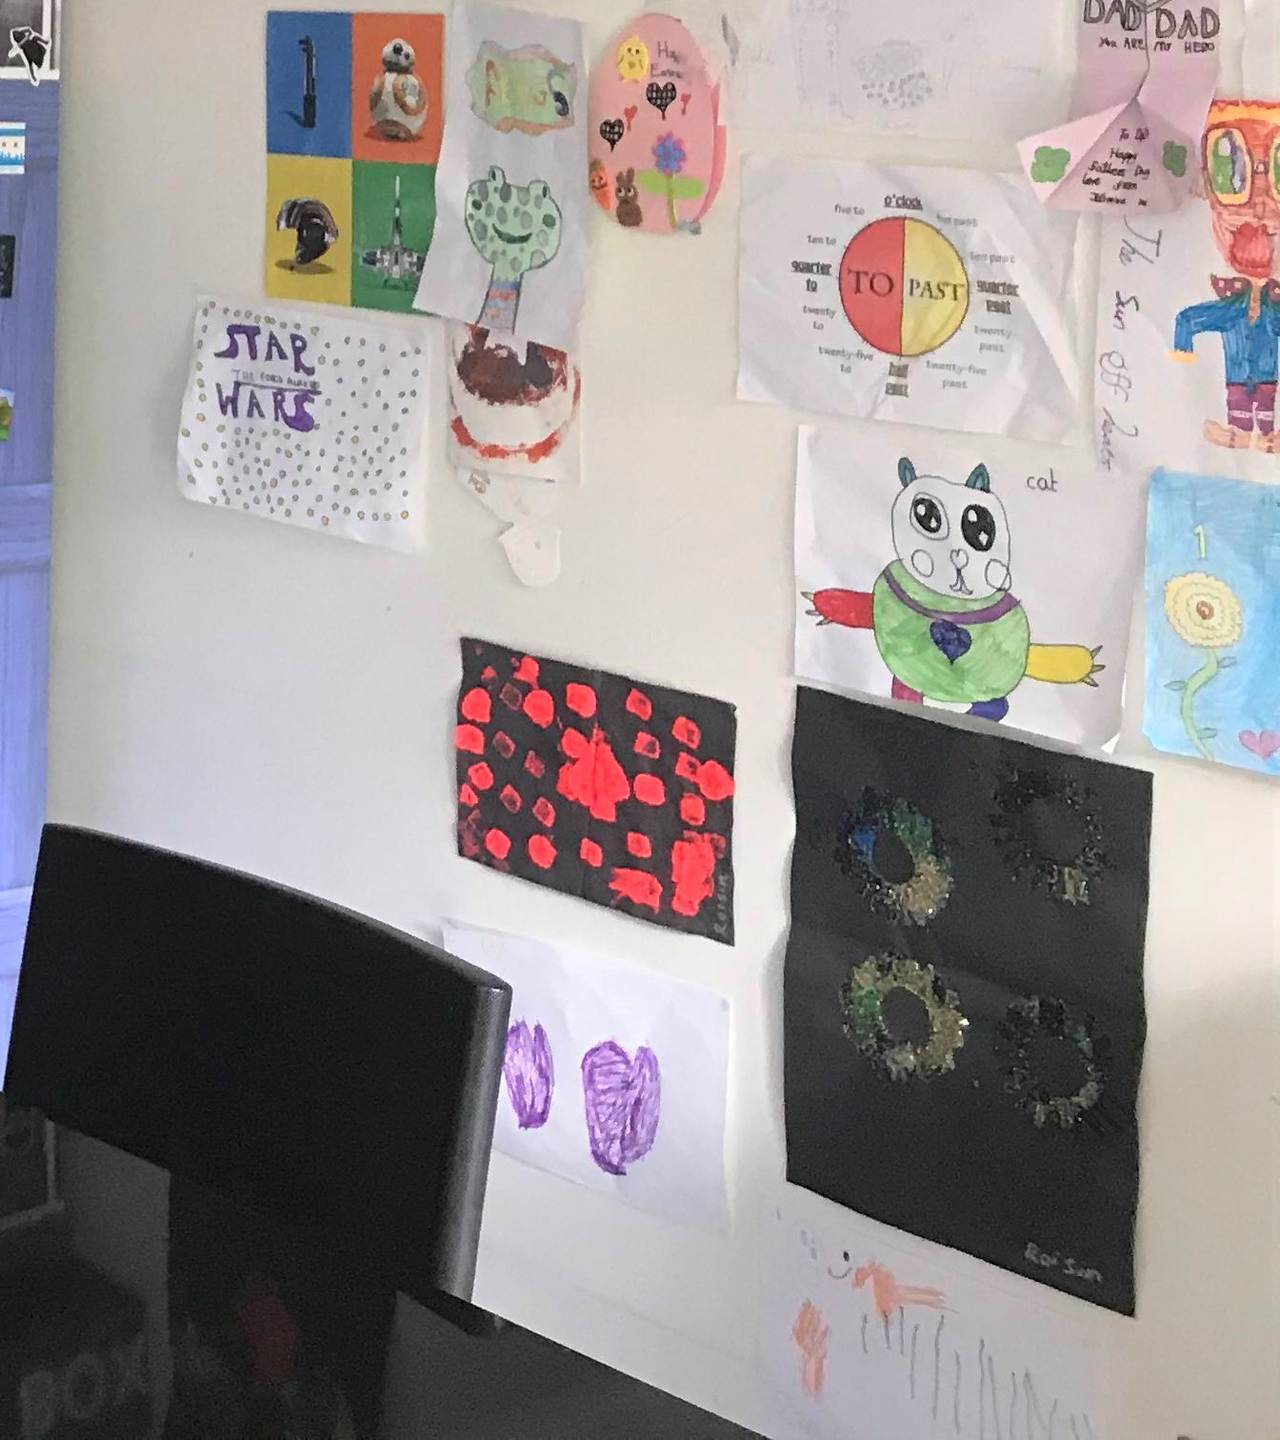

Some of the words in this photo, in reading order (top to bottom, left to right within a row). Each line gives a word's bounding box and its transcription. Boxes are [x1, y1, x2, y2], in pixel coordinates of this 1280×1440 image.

[1155, 7, 1220, 39] DAD
[846, 268, 894, 297] TO
[908, 278, 966, 302] PAST
[213, 324, 316, 377] STAR
[215, 381, 315, 432] WARS
[1026, 467, 1058, 492] cat
